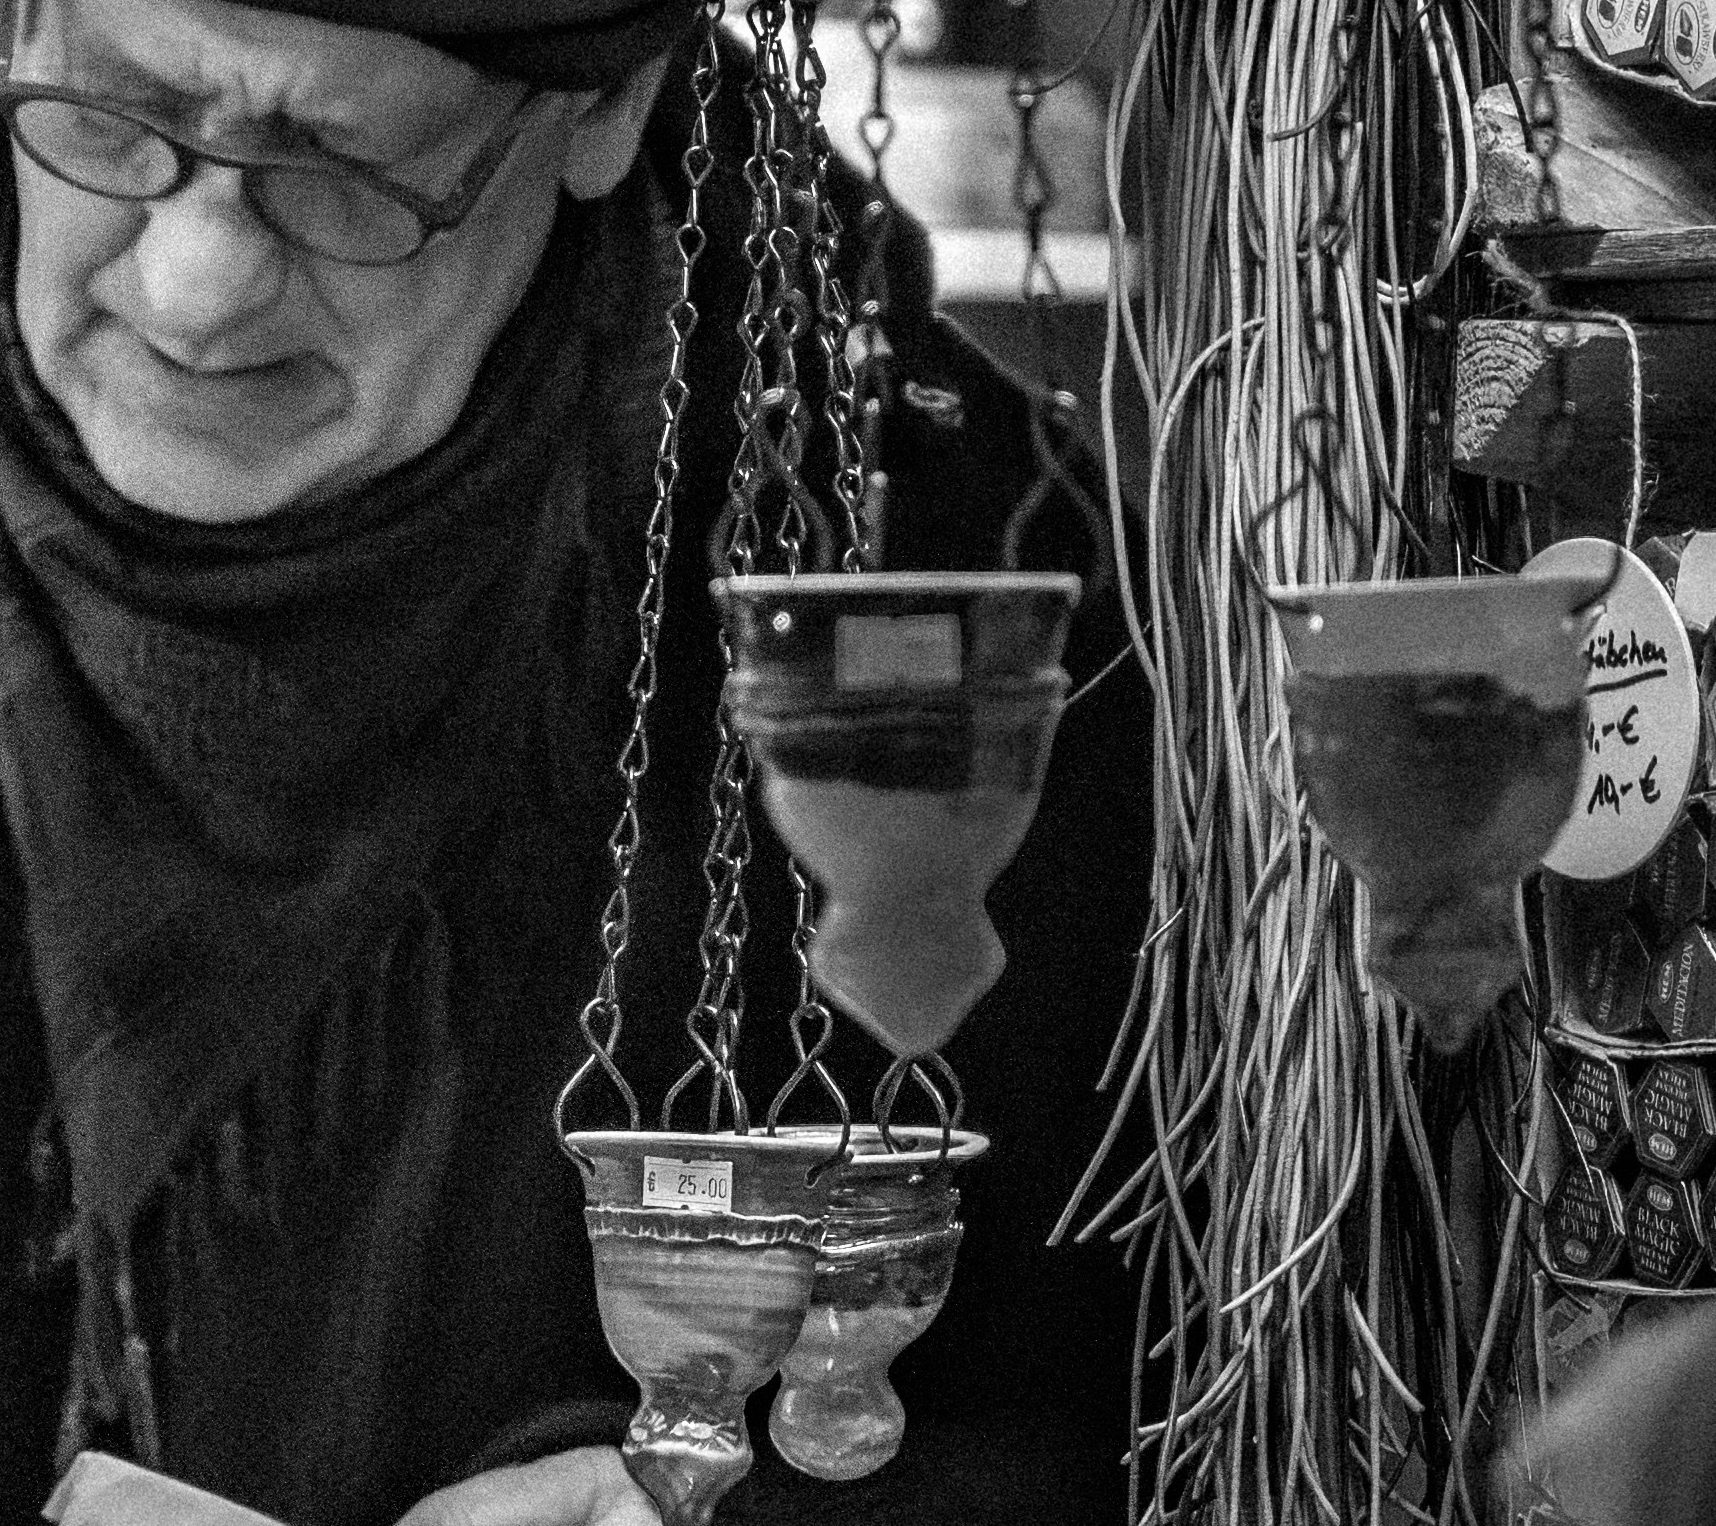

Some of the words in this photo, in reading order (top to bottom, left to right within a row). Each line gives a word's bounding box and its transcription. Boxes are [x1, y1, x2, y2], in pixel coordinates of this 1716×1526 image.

[1644, 1088, 1692, 1121] MAGIC
[1644, 1107, 1688, 1138] BLACK
[677, 1173, 727, 1199] 25.00
[1637, 1206, 1680, 1239] BLACK
[1635, 1224, 1680, 1256] MAGIC
